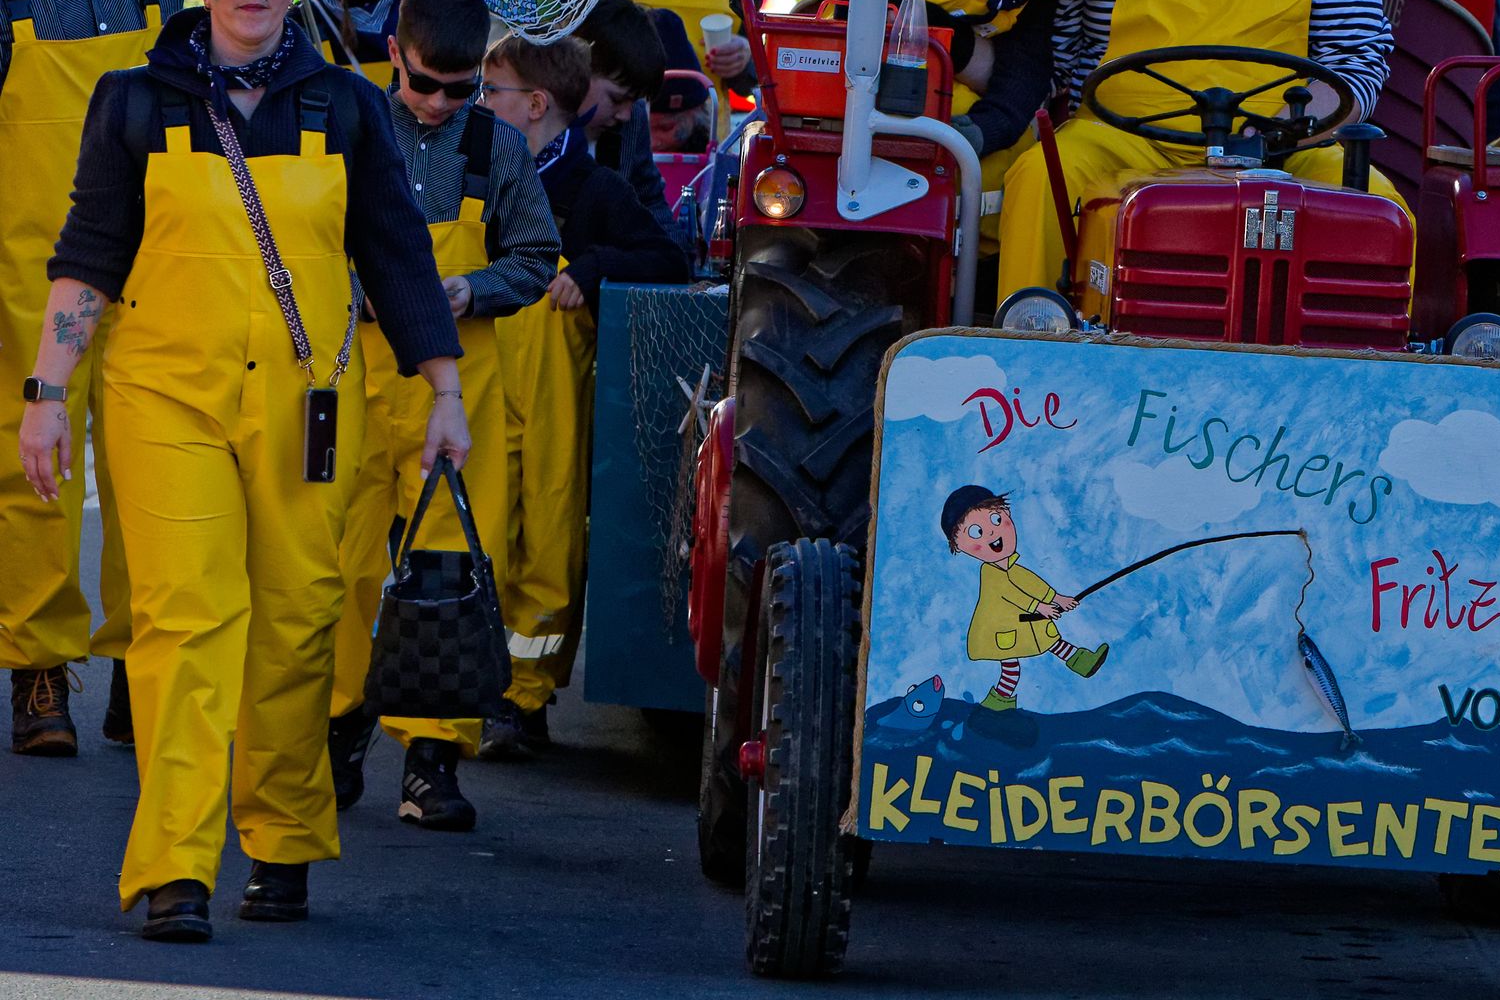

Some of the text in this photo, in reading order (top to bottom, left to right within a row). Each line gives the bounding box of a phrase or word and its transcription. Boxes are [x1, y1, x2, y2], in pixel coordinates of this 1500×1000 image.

[798, 56, 840, 66] Eifelviez
[962, 387, 1393, 525] Die Fischers
